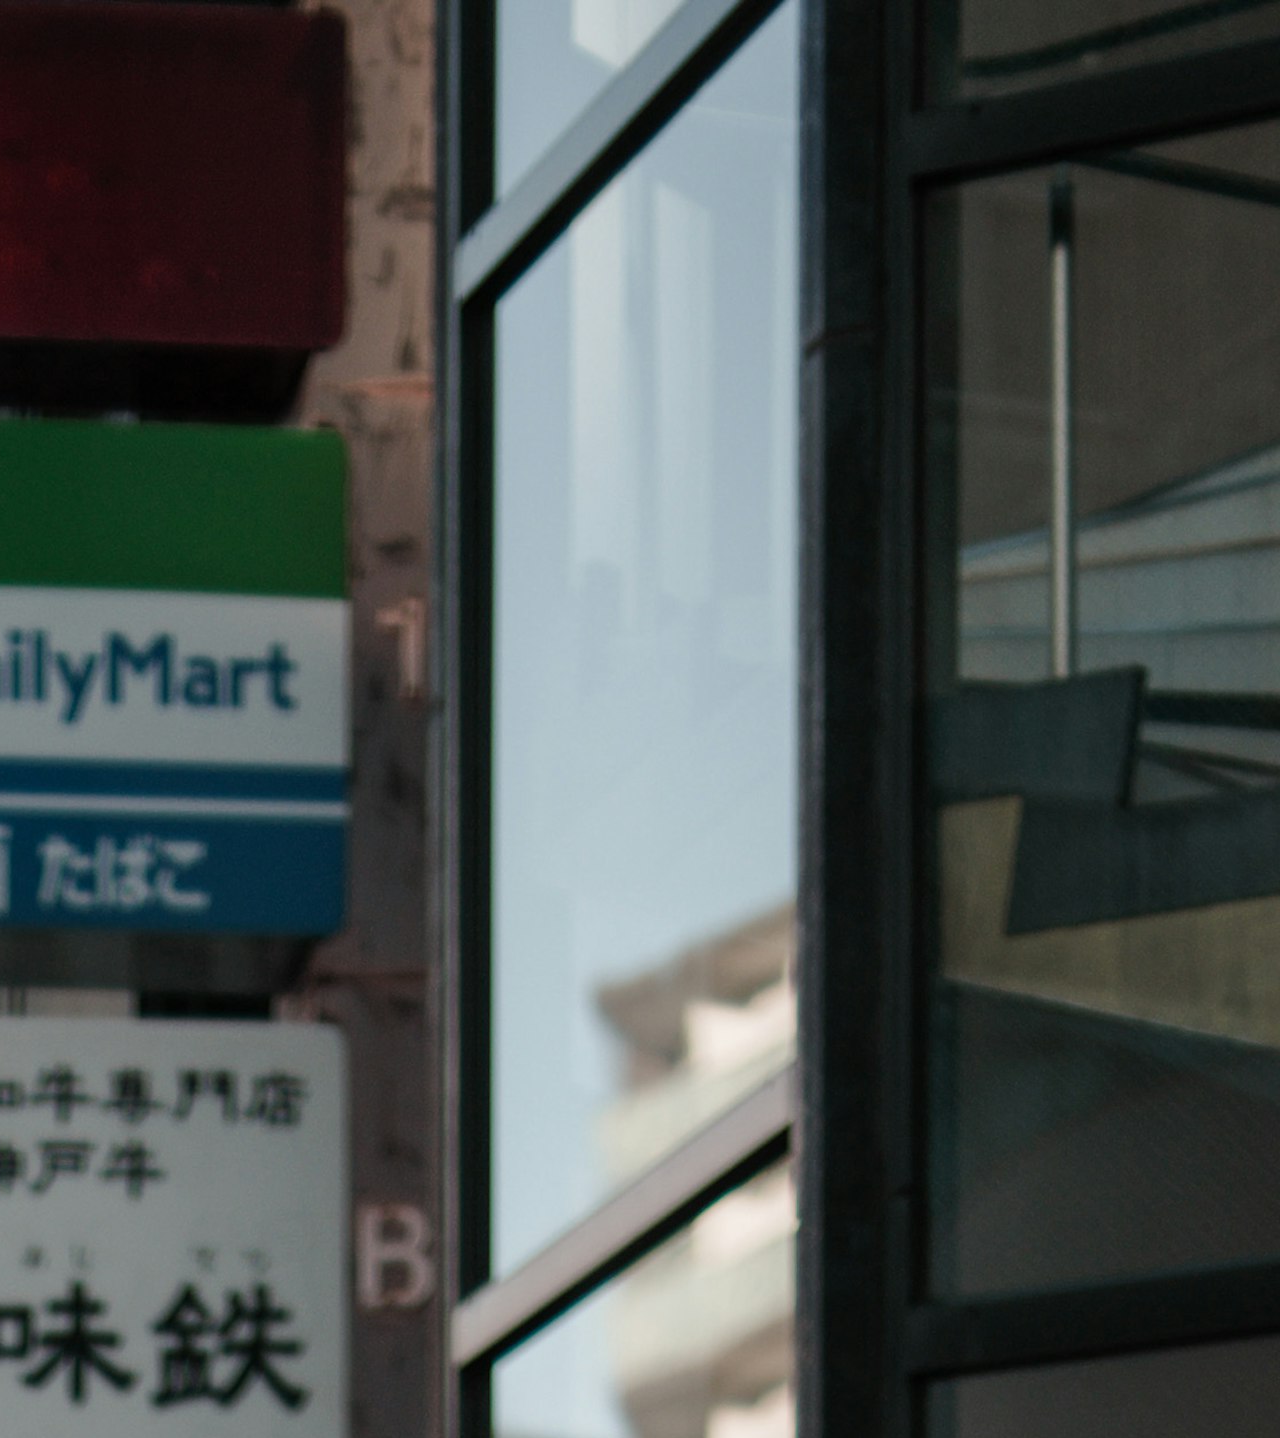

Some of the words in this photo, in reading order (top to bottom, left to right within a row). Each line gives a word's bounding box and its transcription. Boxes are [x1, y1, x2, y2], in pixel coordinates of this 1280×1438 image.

[38, 834, 212, 910] たばこ
[356, 1205, 435, 1308] B
